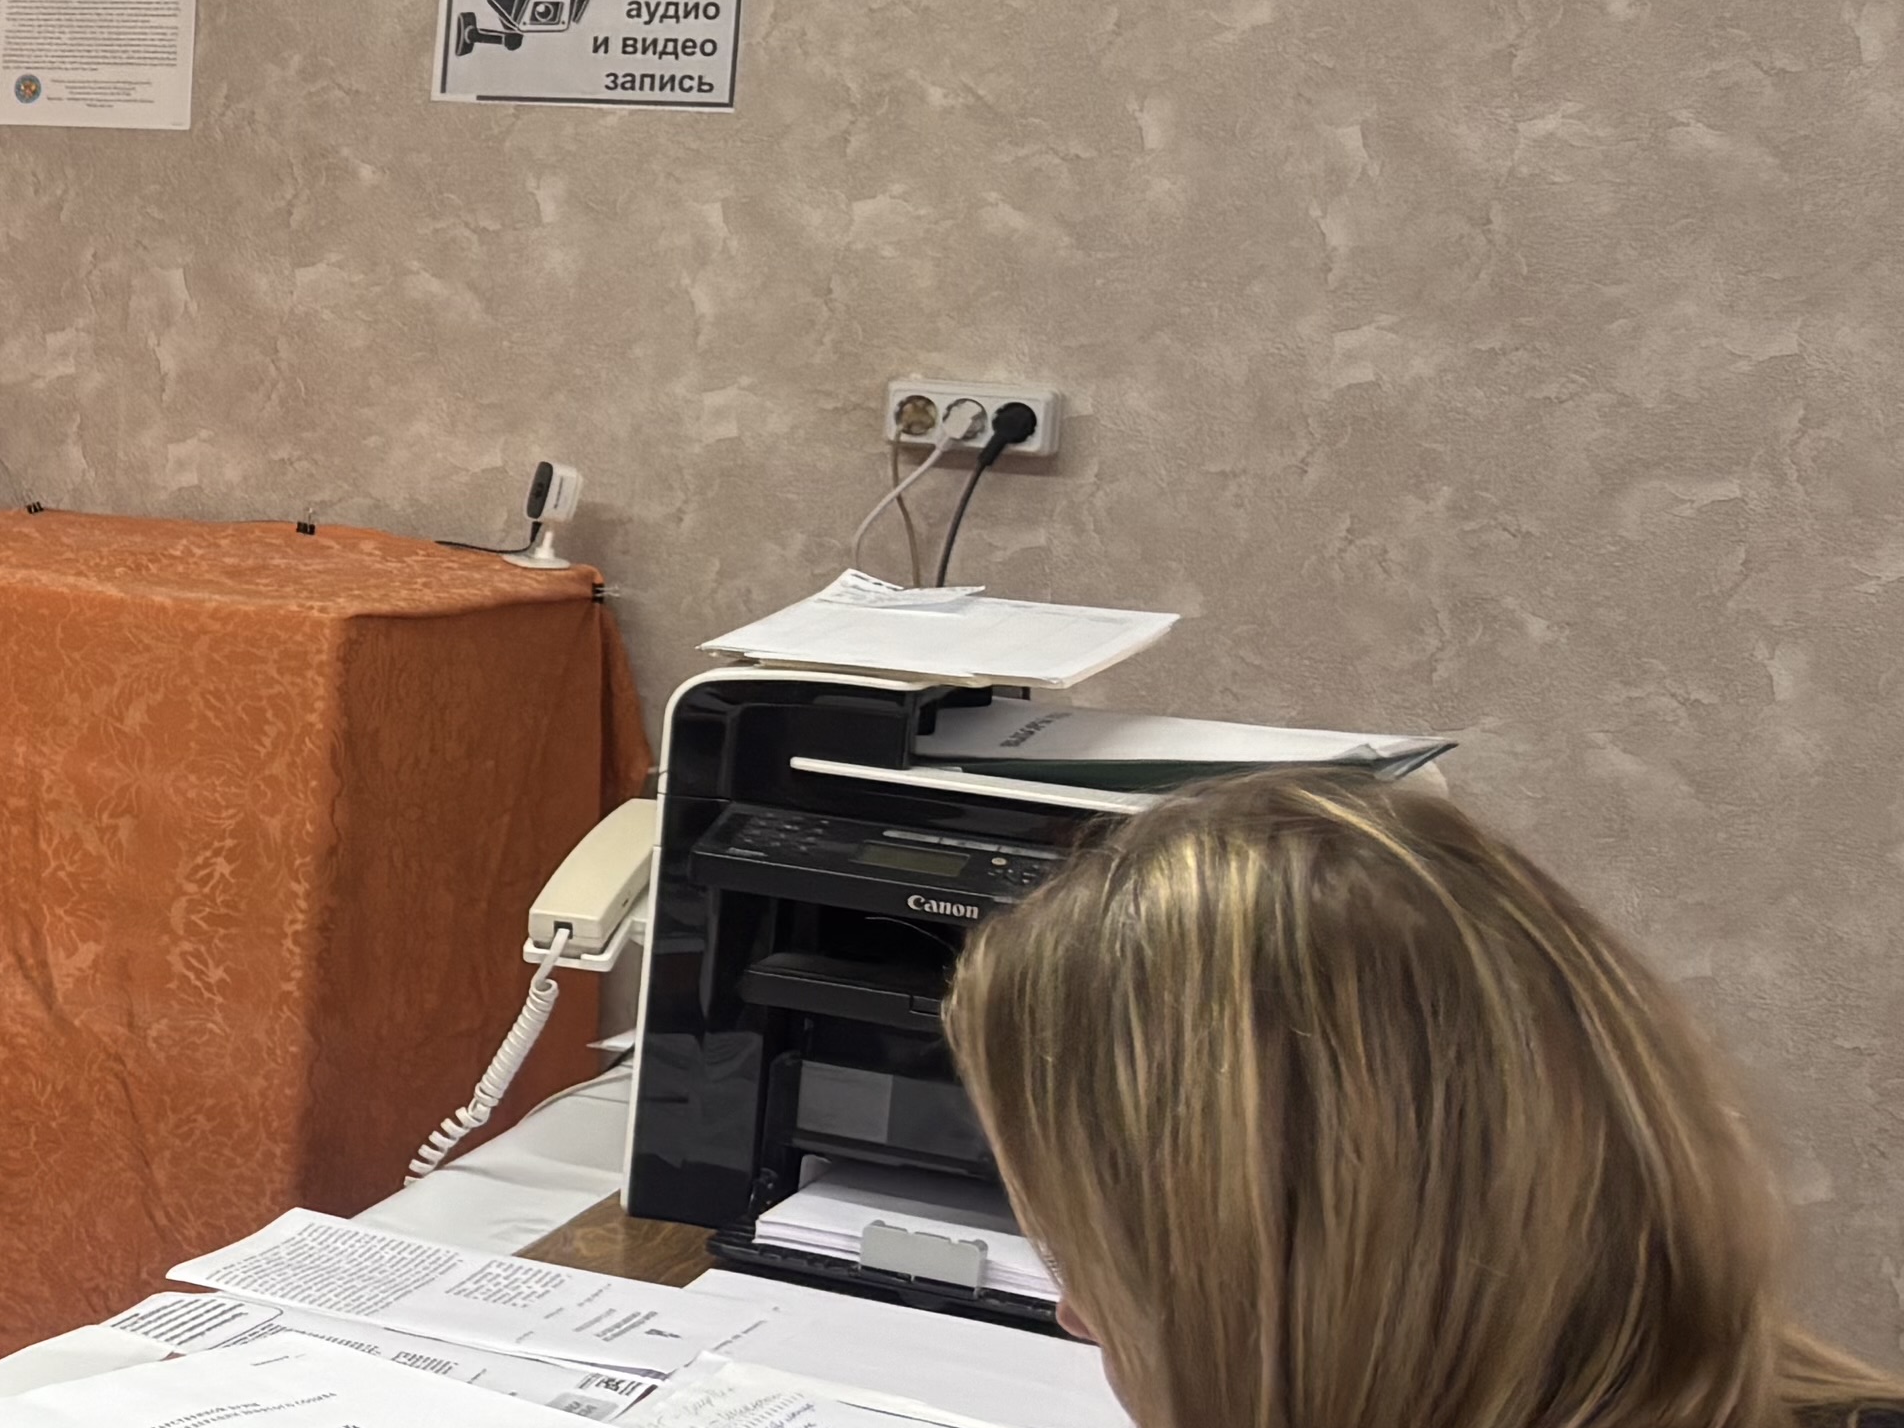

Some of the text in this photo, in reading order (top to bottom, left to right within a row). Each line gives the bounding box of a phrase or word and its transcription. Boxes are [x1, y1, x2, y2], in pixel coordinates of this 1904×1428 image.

[626, 0, 721, 25] аудио
[592, 36, 718, 60] и видео
[604, 72, 715, 93] запись
[907, 894, 979, 920] Canon
